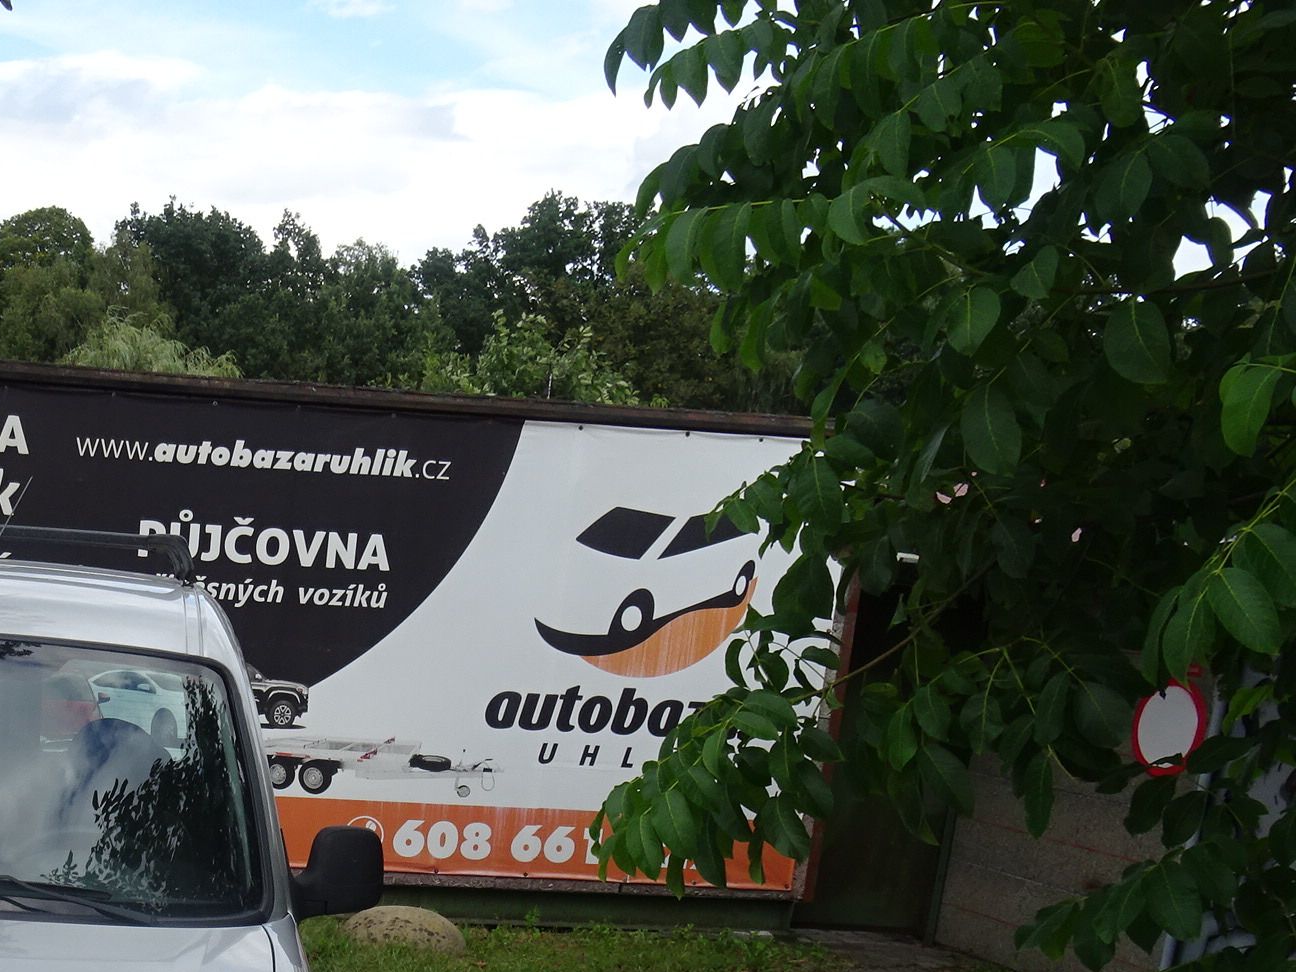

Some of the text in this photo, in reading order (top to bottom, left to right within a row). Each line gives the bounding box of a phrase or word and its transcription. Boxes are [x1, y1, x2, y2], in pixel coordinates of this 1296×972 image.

[75, 436, 452, 481] www.autobazaruhlik.cz
[137, 509, 390, 572] PŮJČOVNA
[298, 583, 388, 608] vozíků
[484, 685, 707, 737] autoba
[537, 742, 634, 769] UHL
[392, 819, 492, 861] 608
